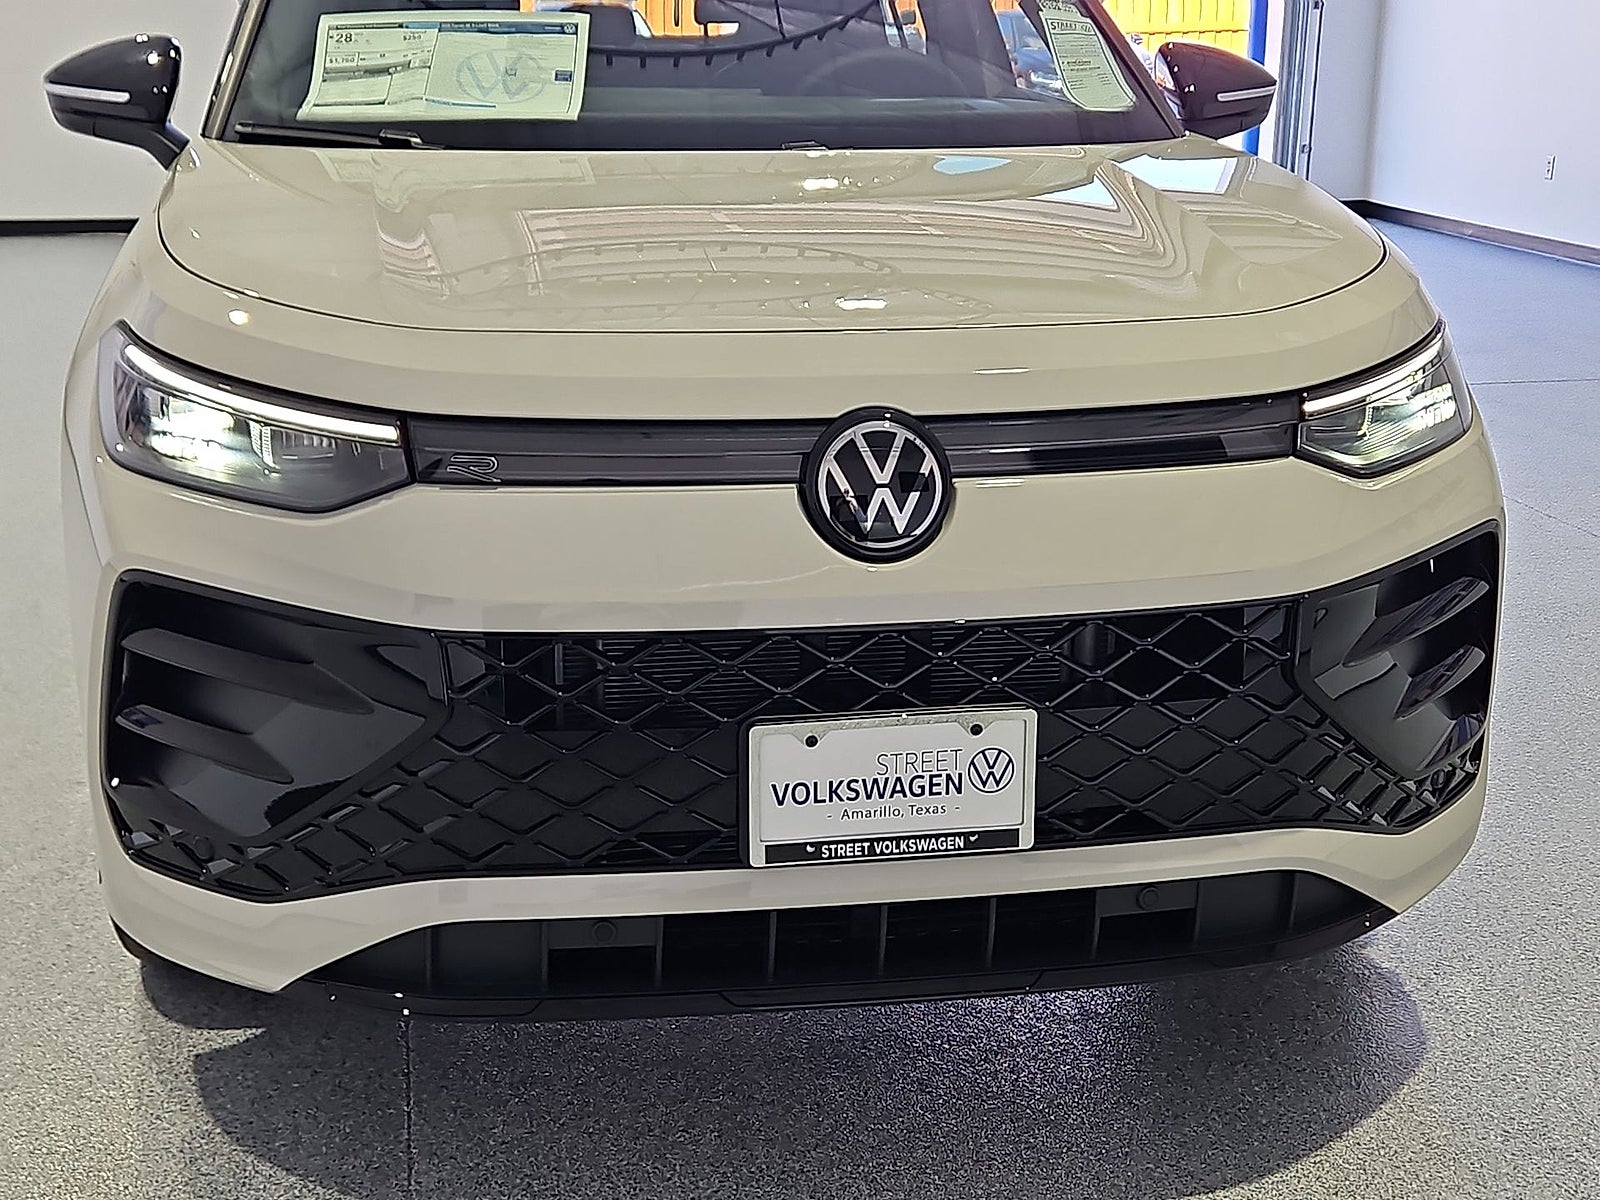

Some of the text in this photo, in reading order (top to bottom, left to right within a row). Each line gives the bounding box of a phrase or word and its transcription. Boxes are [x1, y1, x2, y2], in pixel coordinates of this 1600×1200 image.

[335, 32, 353, 43] 28
[816, 419, 944, 549] VW
[875, 748, 963, 776] STREET
[967, 747, 1015, 794] VW
[770, 772, 964, 807] VOLKSWAGEN
[840, 803, 947, 821] Amarillo, Texas
[821, 835, 965, 859] STREET VOLKSWAGEN
